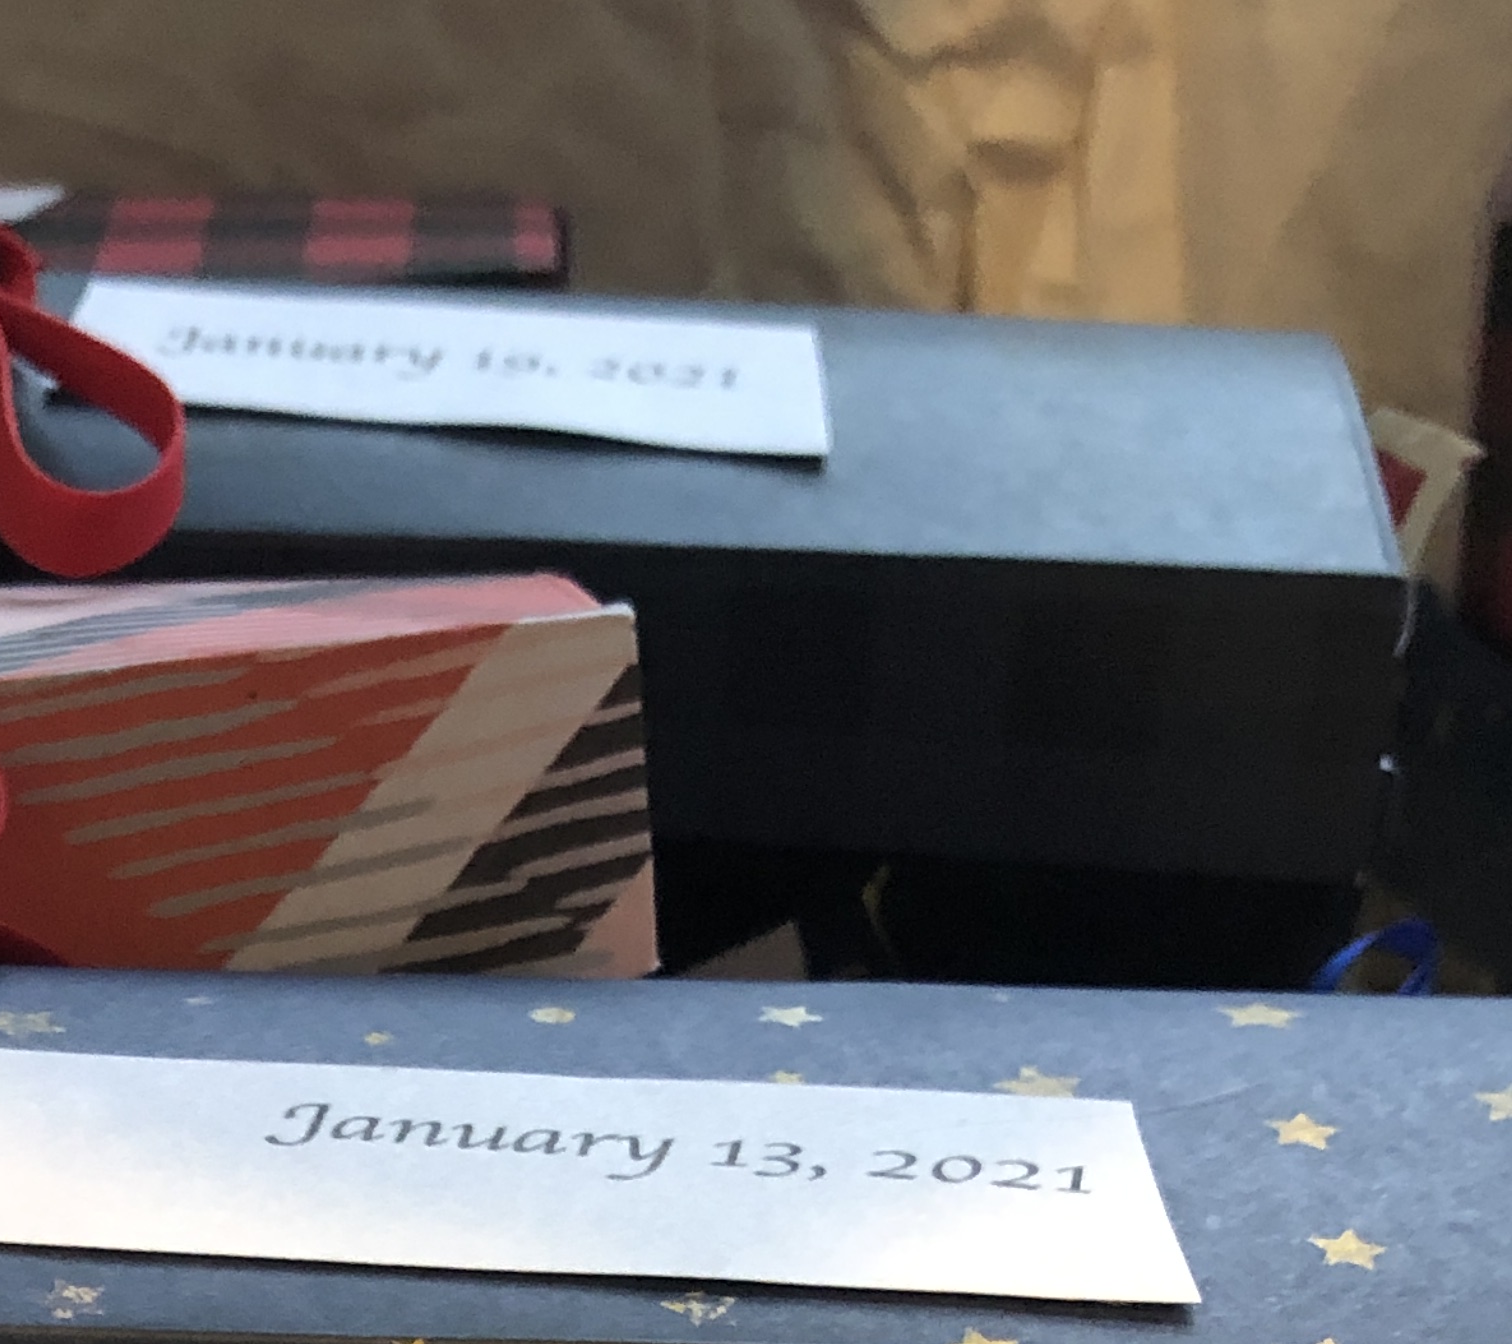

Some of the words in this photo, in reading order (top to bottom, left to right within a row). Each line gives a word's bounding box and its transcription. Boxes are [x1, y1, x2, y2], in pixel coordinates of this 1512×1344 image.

[264, 1103, 676, 1181] January
[710, 1138, 826, 1181] 13,
[867, 1147, 1094, 1194] 2021
